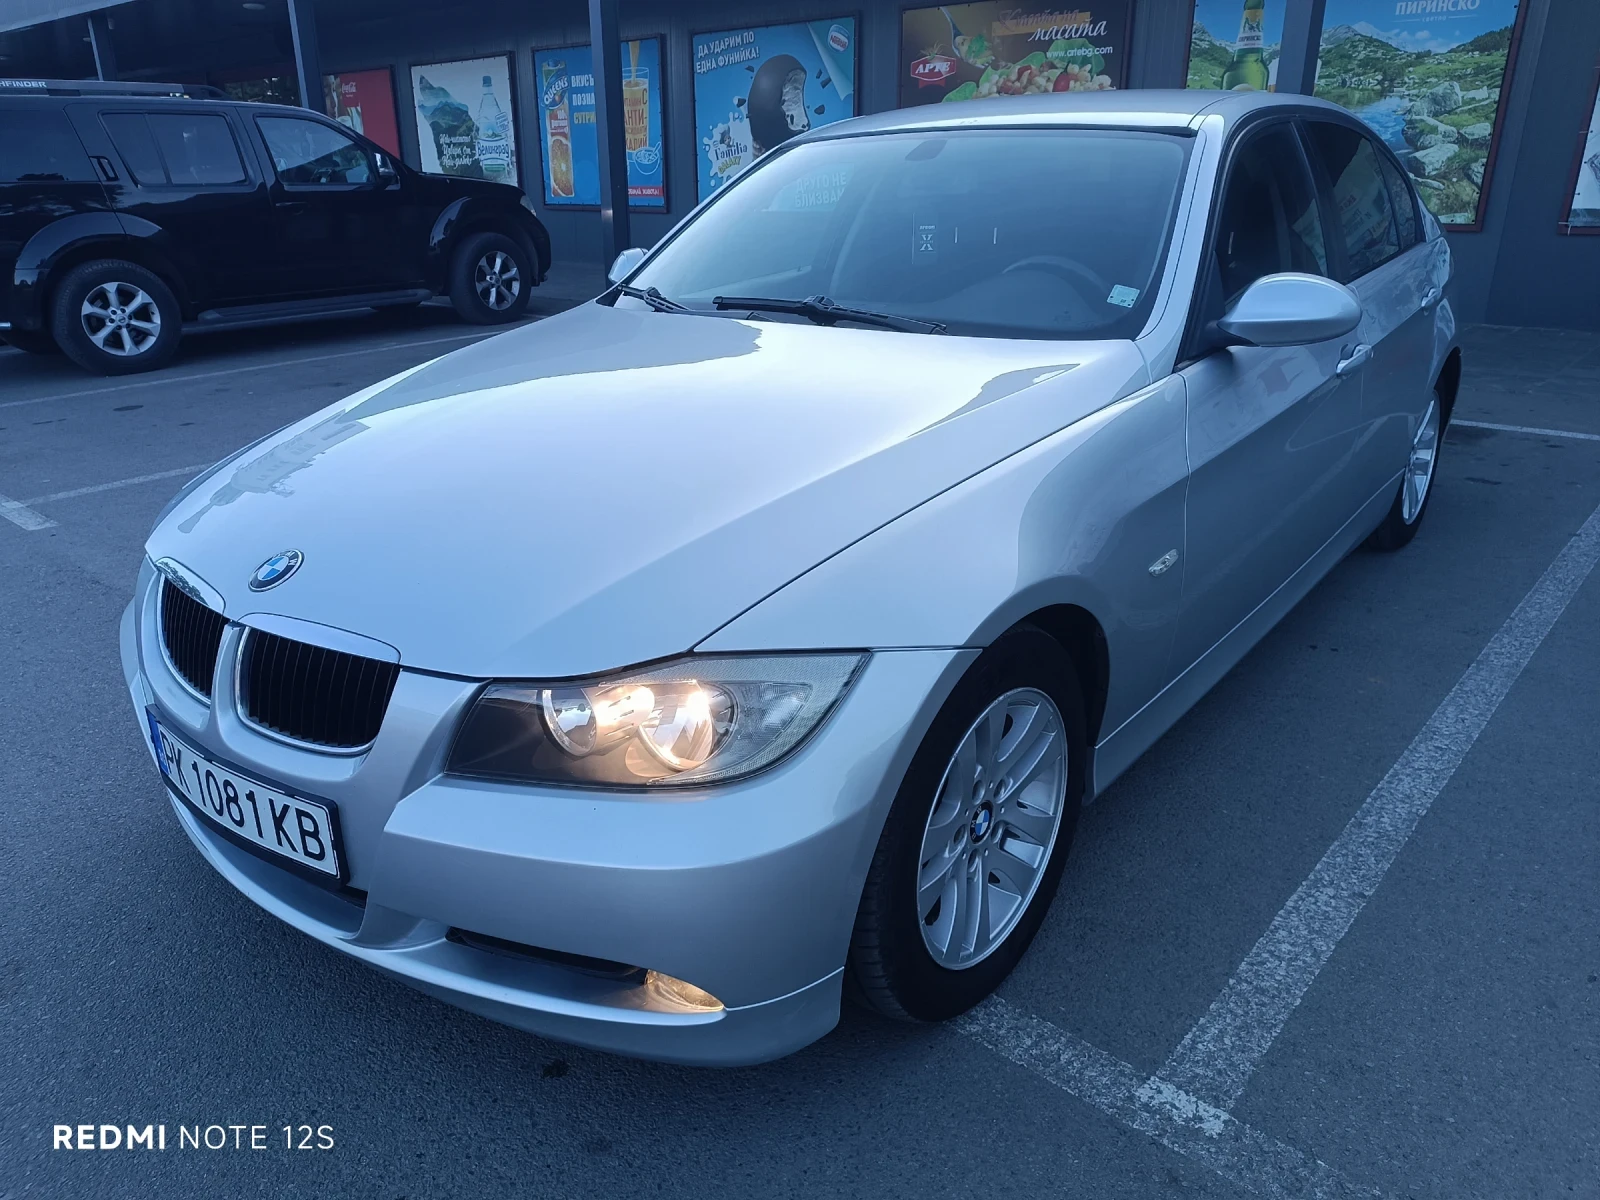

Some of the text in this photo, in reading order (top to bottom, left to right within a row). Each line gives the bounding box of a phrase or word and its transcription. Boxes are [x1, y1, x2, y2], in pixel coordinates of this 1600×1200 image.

[1395, 0, 1481, 15] ПИРИНСКО
[1027, 17, 1108, 42] масата
[698, 31, 755, 59] ДА УДАРИМ ПО
[1046, 46, 1113, 58] www.artebg.com
[696, 46, 760, 74] ЕДНА ФУНИЙКА!
[571, 74, 595, 88] ВКУСЪ
[572, 92, 595, 106] ПОЗНА
[573, 111, 597, 125] СУТРИ
[714, 141, 748, 161] Familia
[831, 171, 847, 187] НЕ
